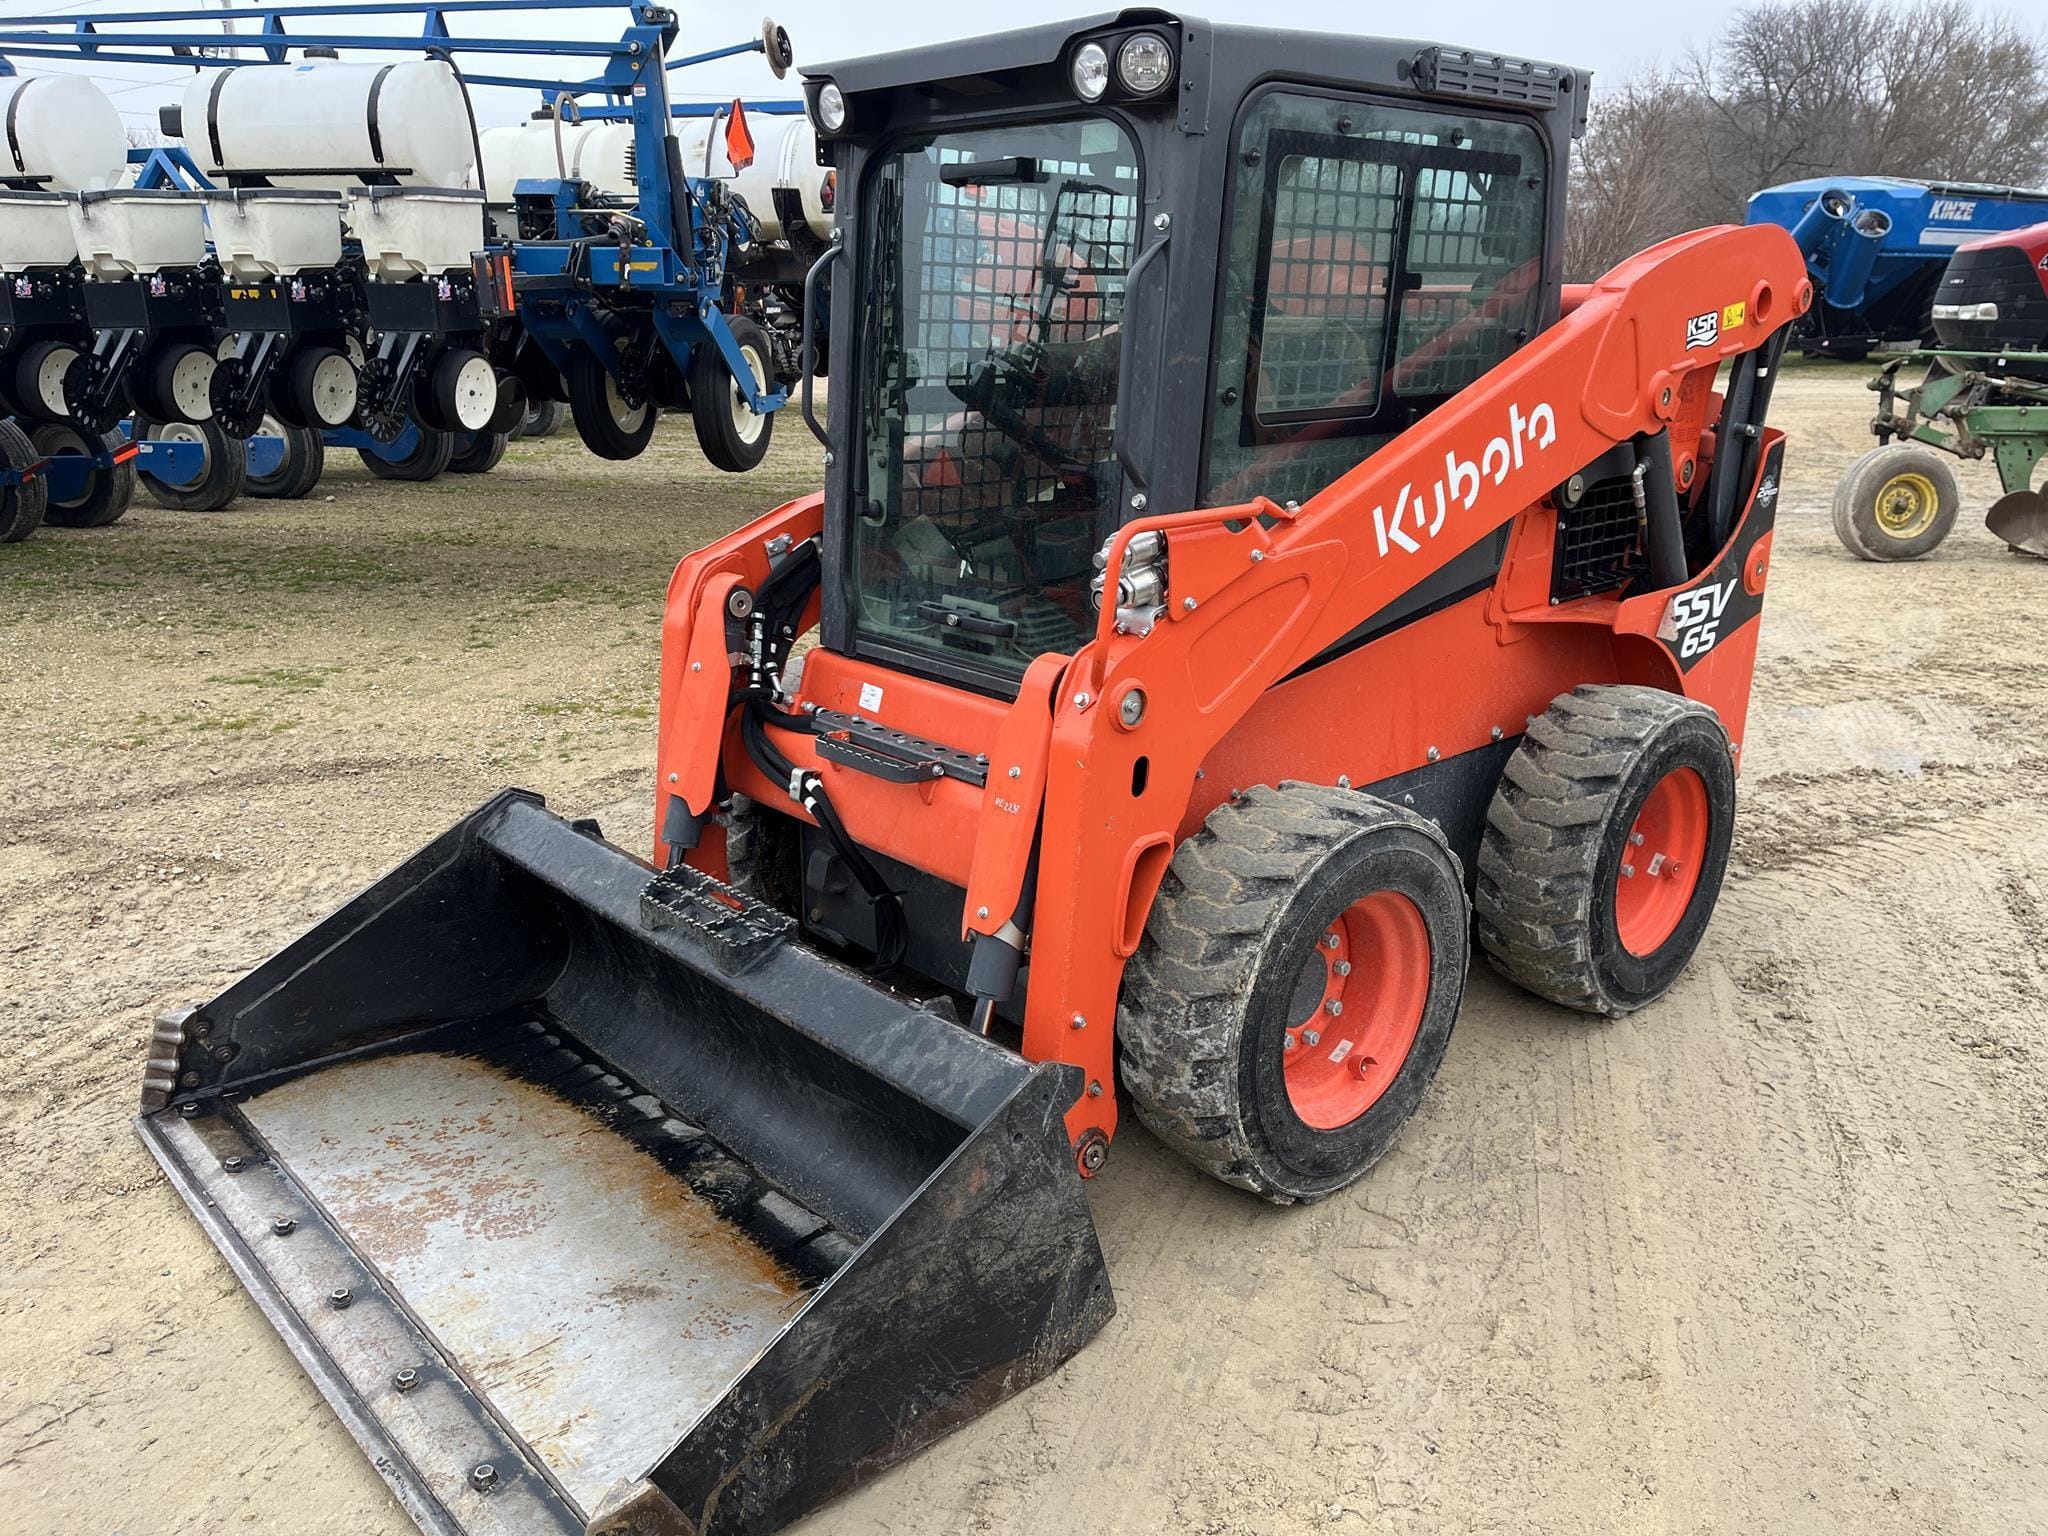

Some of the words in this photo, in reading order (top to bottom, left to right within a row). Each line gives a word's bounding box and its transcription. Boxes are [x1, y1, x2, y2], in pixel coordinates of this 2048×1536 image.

[1928, 199, 1977, 221] KINZE
[1687, 311, 1718, 338] KSR
[1372, 402, 1557, 558] Kubota
[1673, 578, 1738, 630] SSV
[1680, 619, 1720, 659] 65
